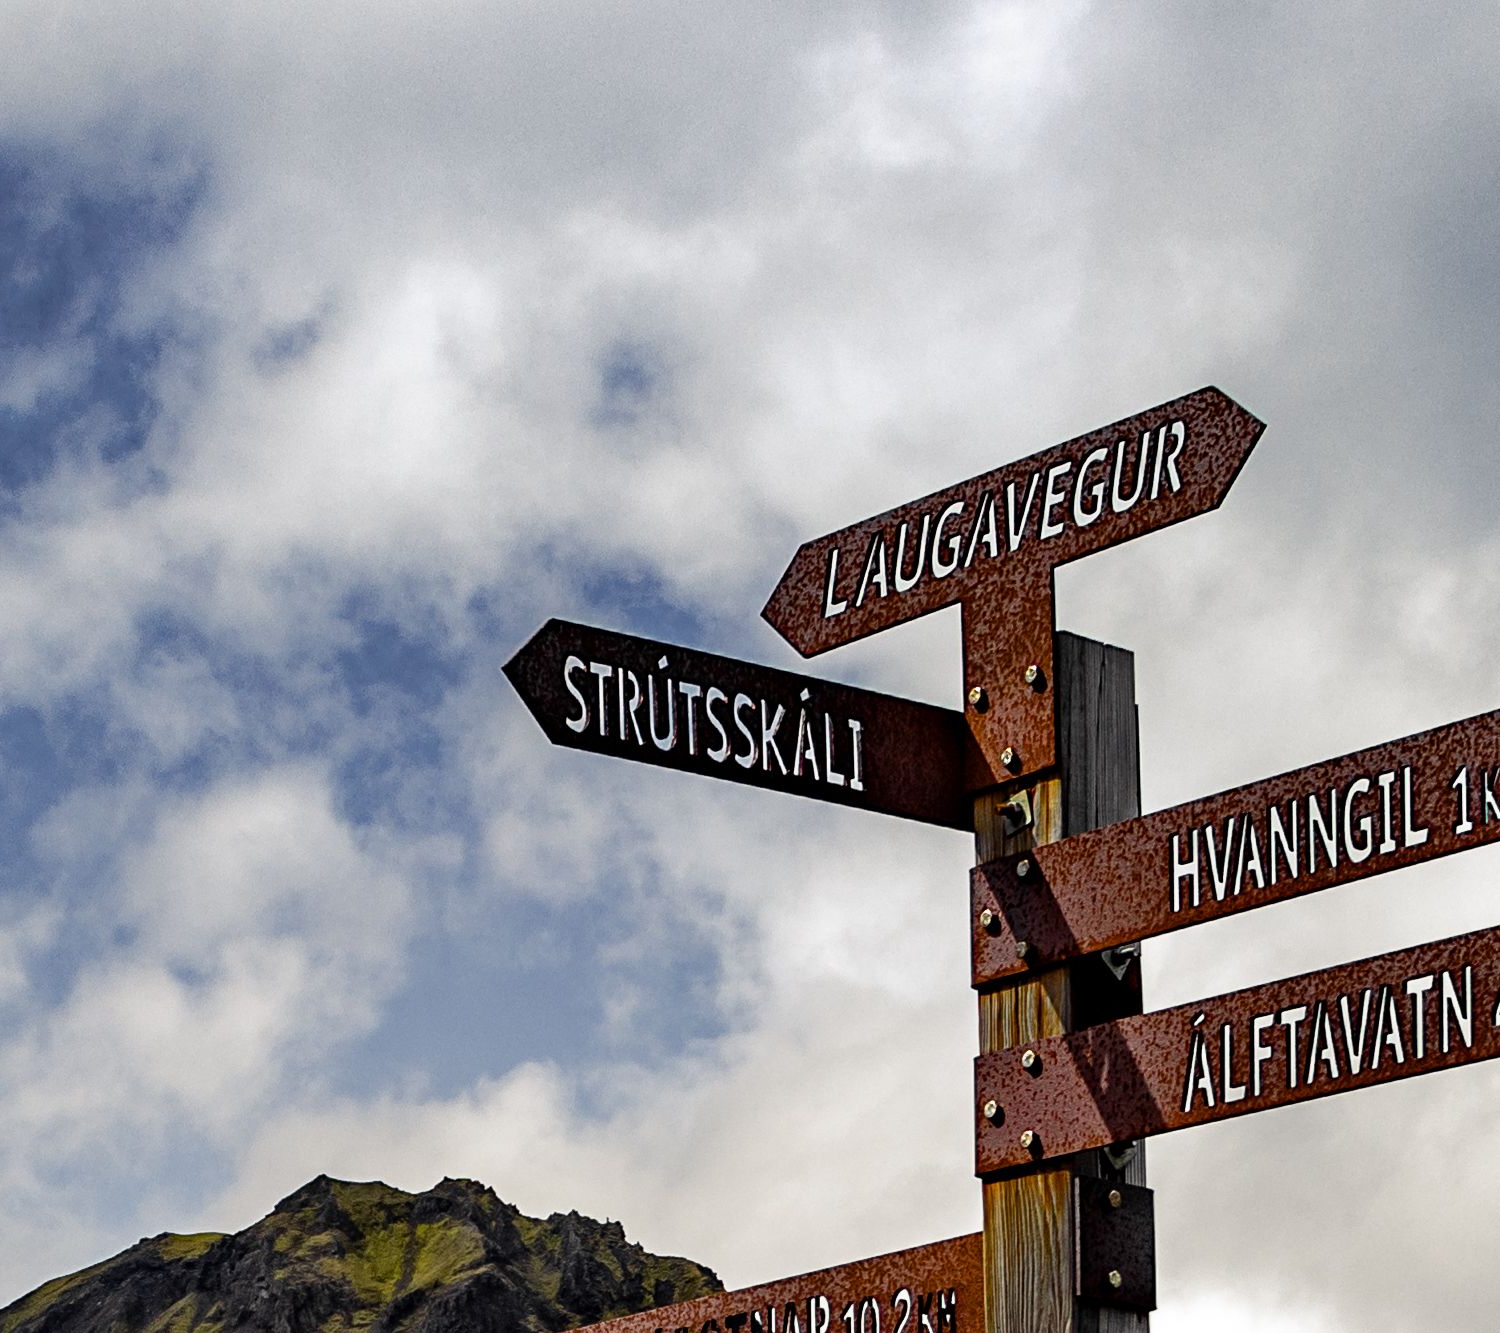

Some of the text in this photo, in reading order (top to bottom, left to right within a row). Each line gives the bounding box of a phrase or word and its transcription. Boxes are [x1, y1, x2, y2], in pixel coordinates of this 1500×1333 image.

[825, 421, 1185, 619] LAUGAVEGUR
[564, 655, 864, 791] STRÚTSSKÁLI
[1173, 765, 1428, 912] HVANNGIL
[1184, 966, 1472, 1113] ÁLFTAVATN
